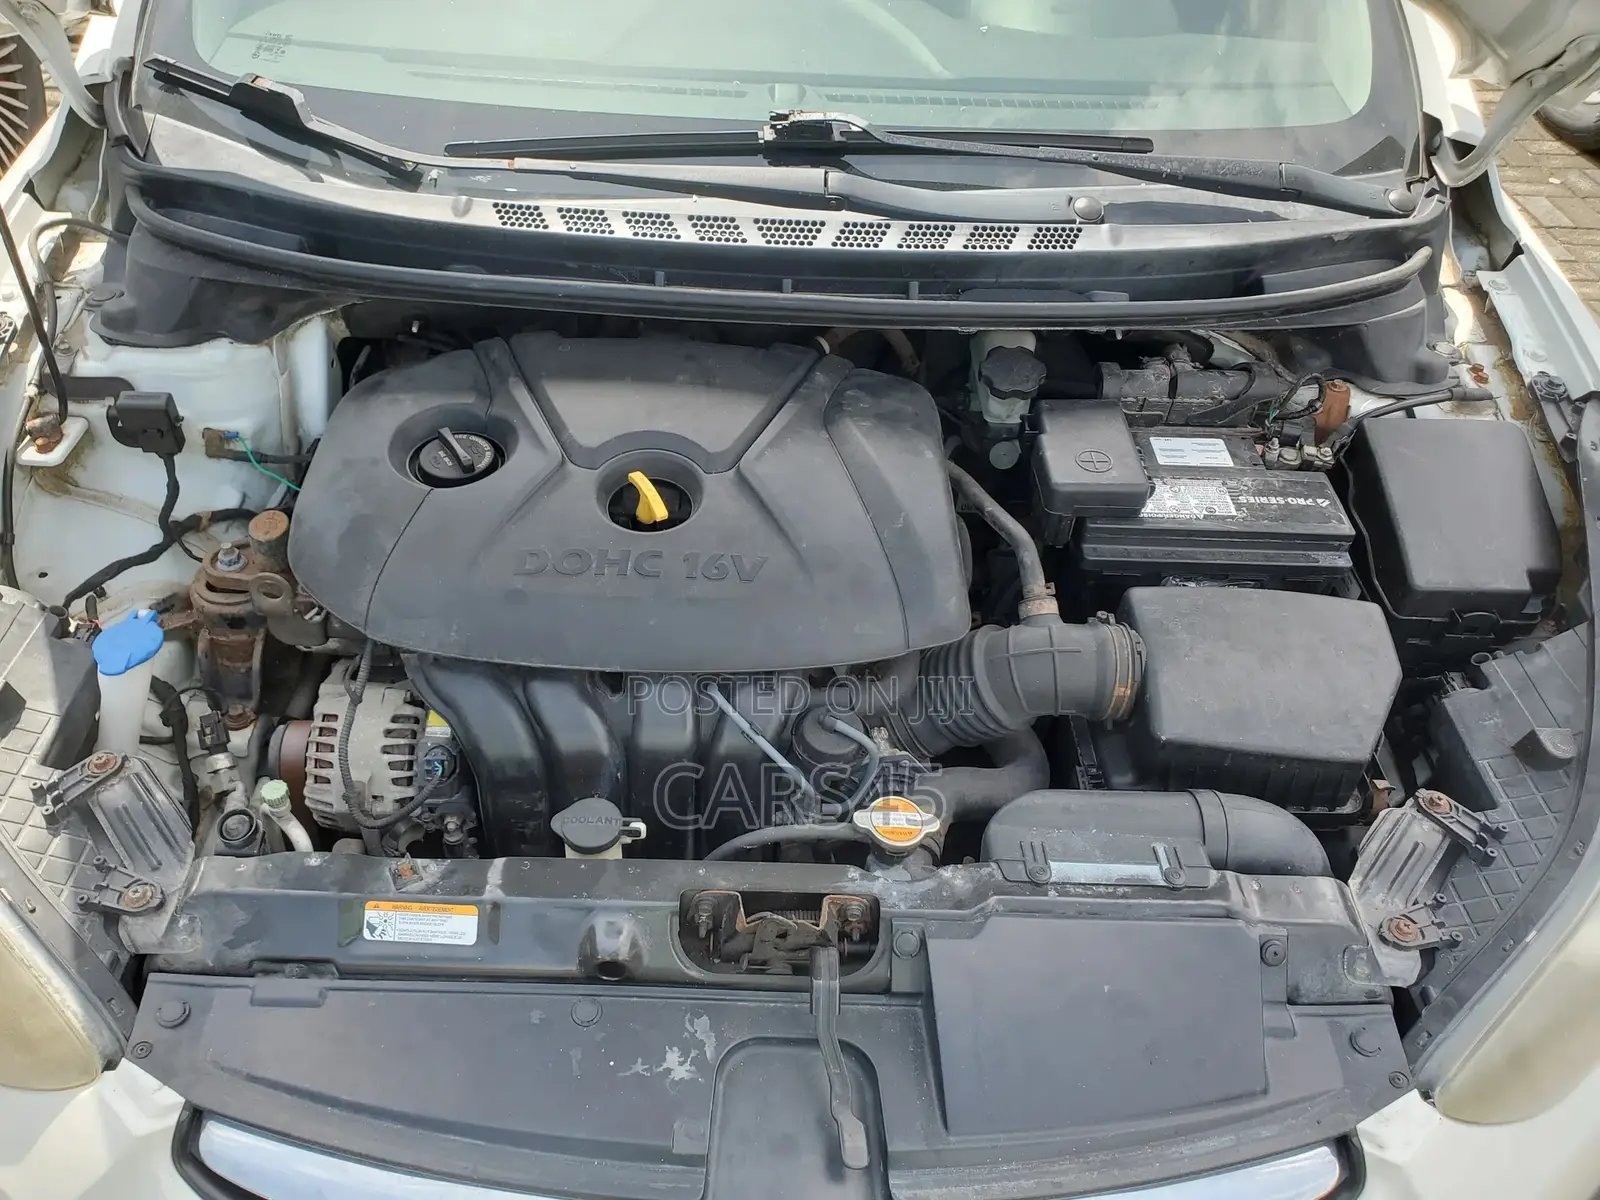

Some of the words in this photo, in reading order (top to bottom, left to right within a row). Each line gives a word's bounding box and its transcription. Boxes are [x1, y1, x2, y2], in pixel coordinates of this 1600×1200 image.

[513, 548, 664, 578] DOHC
[682, 551, 769, 583] 16V
[562, 816, 622, 827] COOLANT
